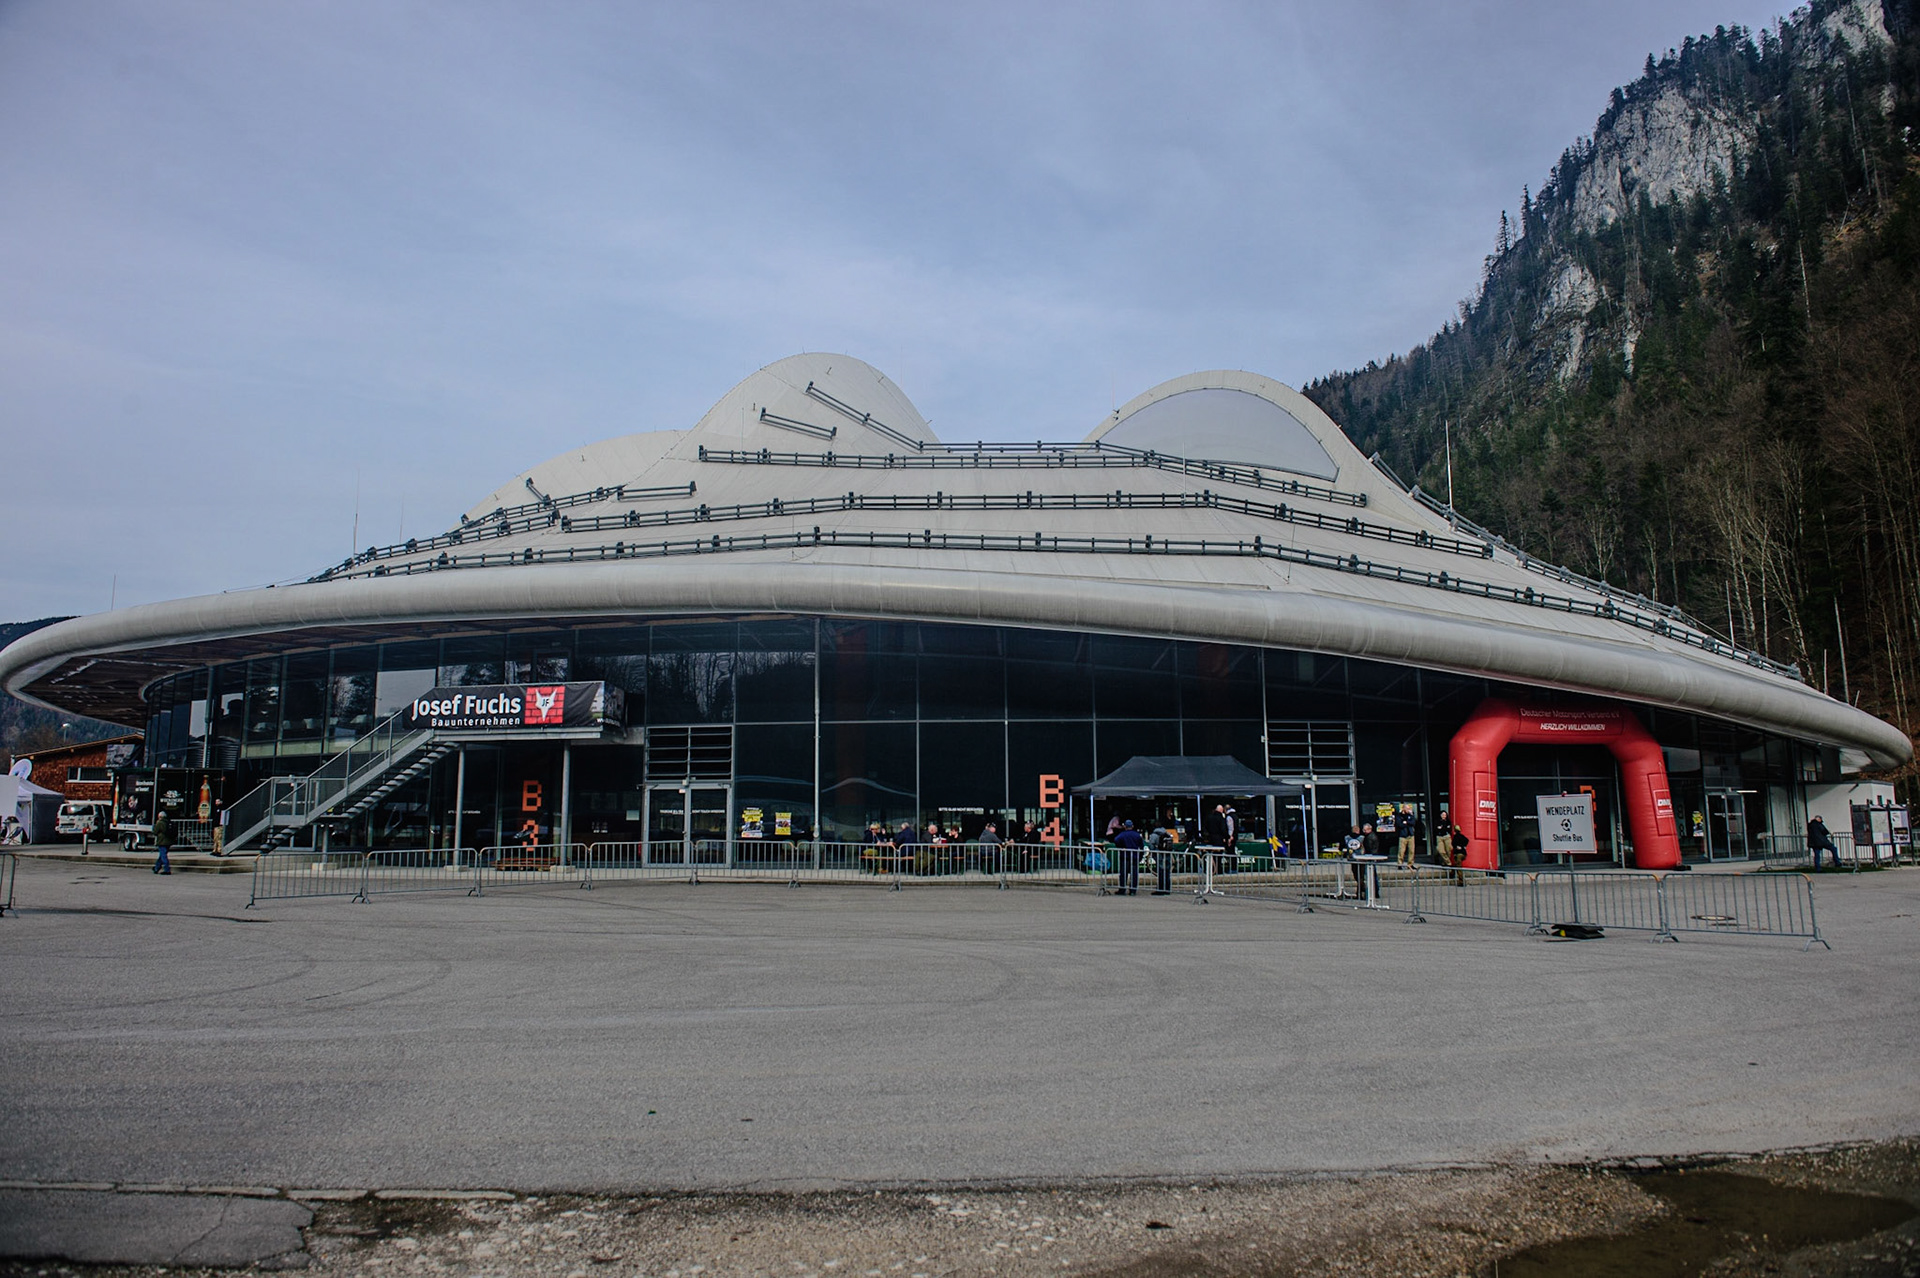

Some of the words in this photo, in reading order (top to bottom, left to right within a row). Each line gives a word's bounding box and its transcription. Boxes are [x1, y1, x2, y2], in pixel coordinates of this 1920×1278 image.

[411, 694, 462, 721] Josef
[465, 693, 521, 715] Fuchs
[1520, 708, 1551, 718] Deutscher
[1552, 710, 1585, 719] Motorsport
[431, 717, 520, 727] Bauunternehmen
[1540, 722, 1567, 731] HERZLICH
[1567, 723, 1605, 731] WILLKOMMEN
[522, 780, 542, 811] B
[1040, 774, 1064, 808] B
[1545, 805, 1585, 816] WENDEPLATZ
[1040, 817, 1064, 850] 4
[1552, 833, 1572, 842] Shuttle
[1573, 833, 1583, 842] Bus
